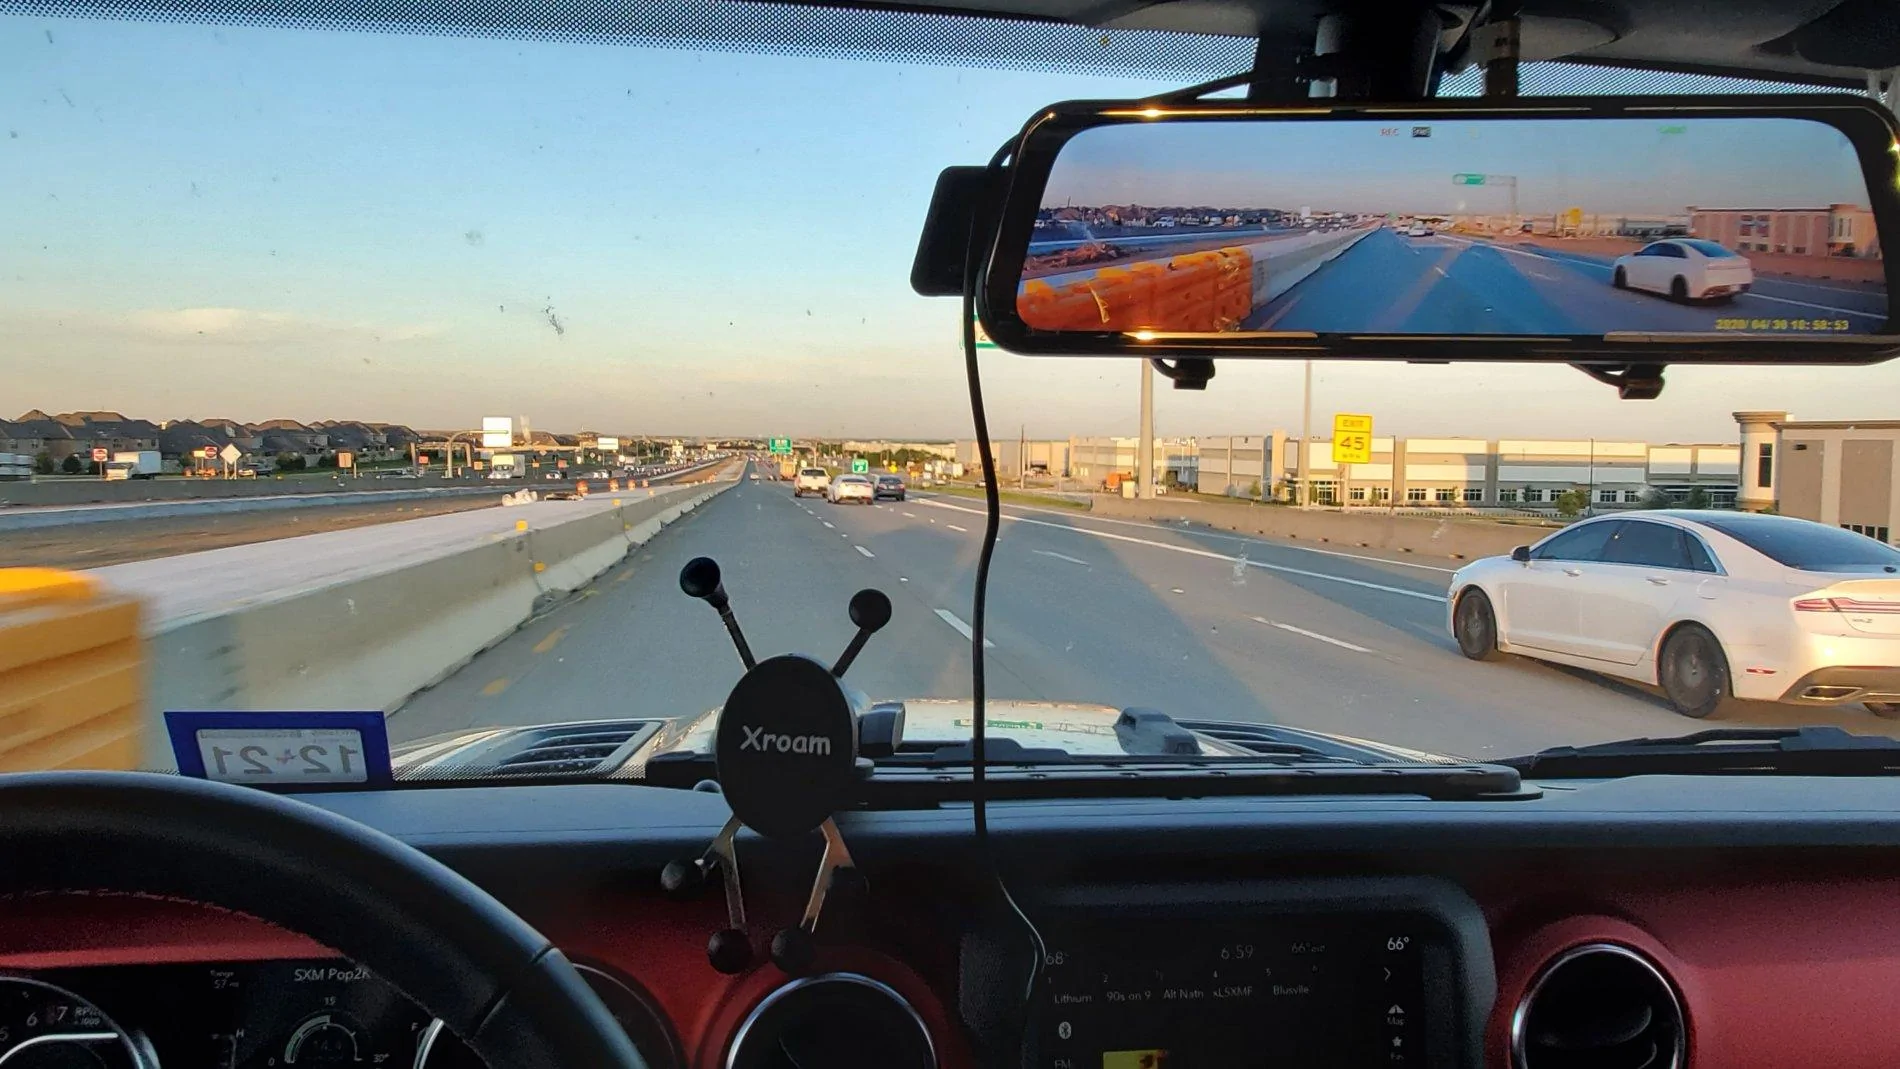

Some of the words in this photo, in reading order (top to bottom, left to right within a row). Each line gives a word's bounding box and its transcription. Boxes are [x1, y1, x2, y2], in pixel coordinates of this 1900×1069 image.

[1380, 128, 1400, 137] REC
[1340, 436, 1365, 451] 45
[740, 725, 831, 756] Xroam
[1387, 936, 1410, 951] 66°
[293, 968, 325, 982] SXM
[1054, 992, 1093, 1004] Lithium
[1106, 990, 1126, 1002] 90s
[26, 1011, 38, 1027] 6
[57, 1006, 68, 1021] 7
[236, 1028, 245, 1037] H
[411, 1022, 418, 1031] F
[268, 1057, 275, 1066] 0
